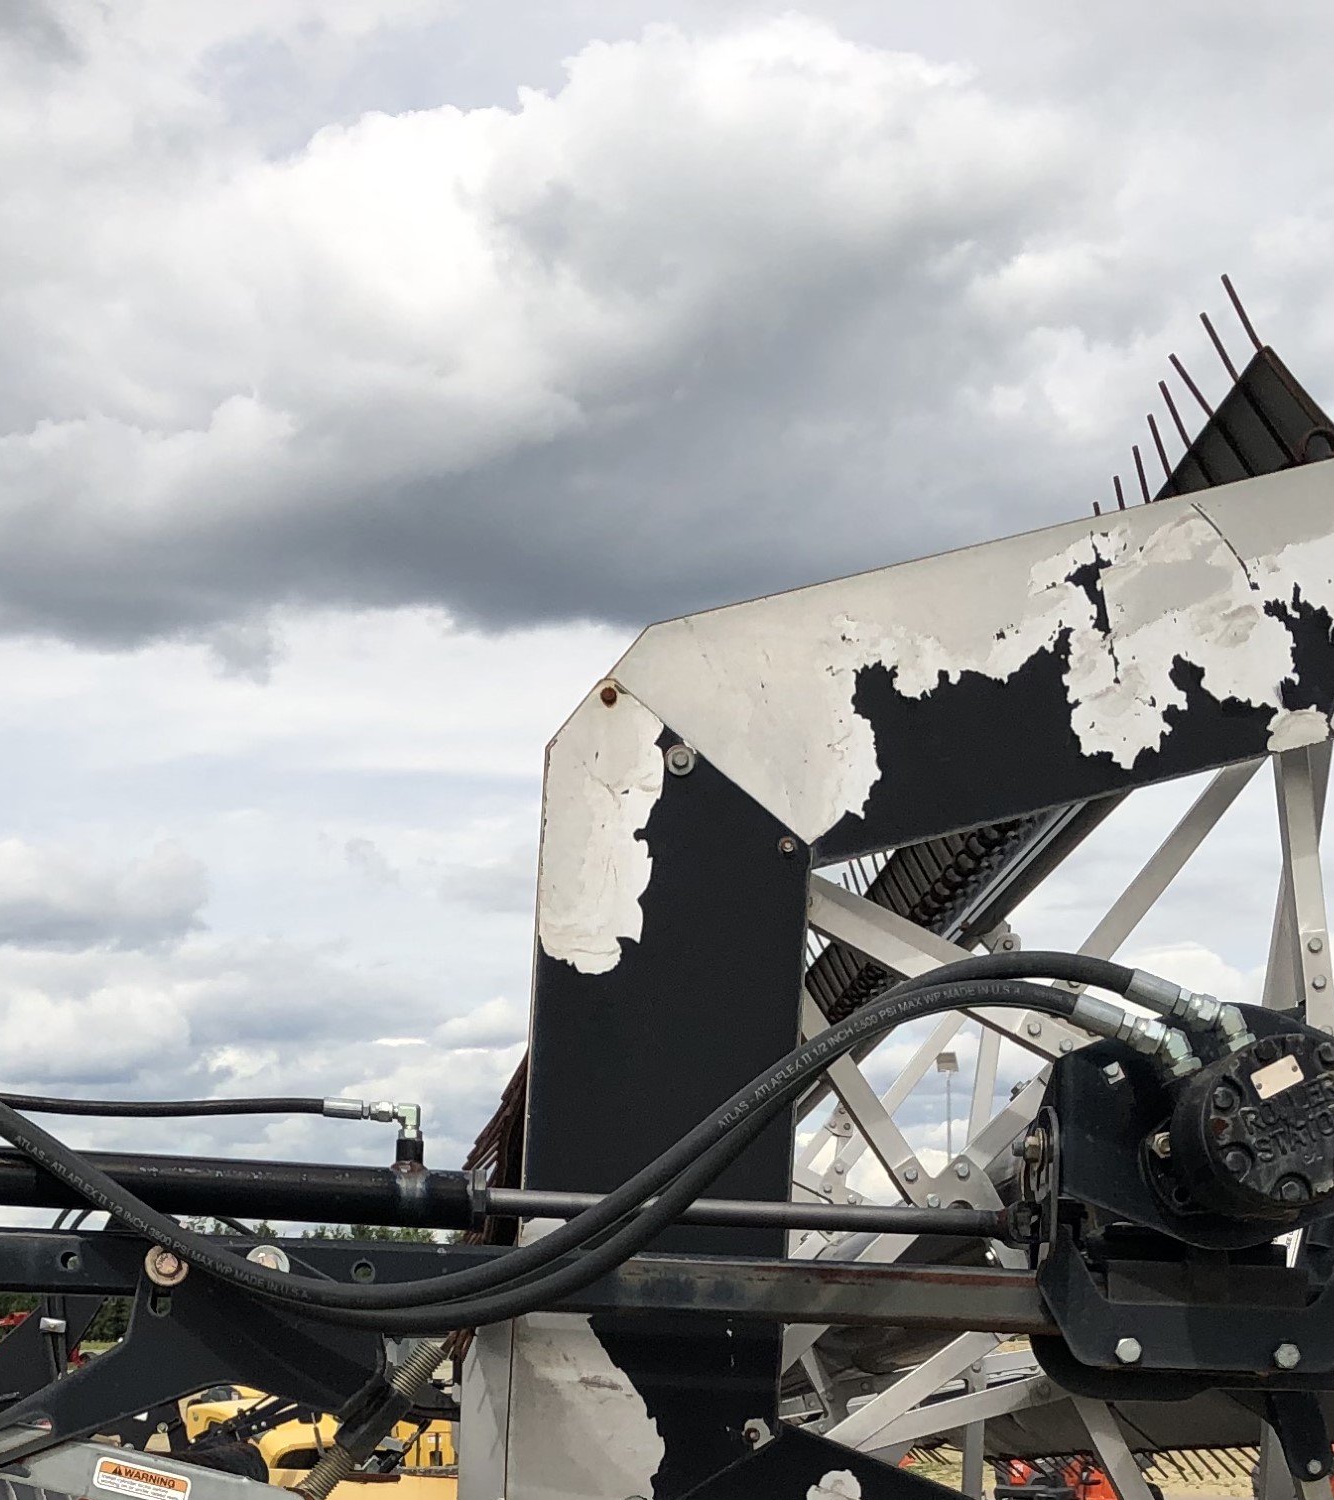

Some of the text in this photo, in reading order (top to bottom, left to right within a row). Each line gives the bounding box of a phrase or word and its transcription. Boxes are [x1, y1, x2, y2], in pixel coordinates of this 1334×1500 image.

[717, 1100, 749, 1129] ATLAS
[754, 1058, 803, 1101] ATLAFLEX
[812, 1042, 828, 1057] 1/2
[827, 1026, 854, 1048] INCH
[879, 1005, 898, 1020] PSI
[897, 997, 923, 1013] MAX
[923, 991, 942, 1005] WP
[943, 985, 976, 999] MADE
[977, 983, 989, 995] IN
[14, 1135, 46, 1160] ATLAS
[50, 1161, 99, 1198] ATLAFLEX
[109, 1201, 123, 1215] 1/2
[124, 1211, 148, 1231] INCH
[148, 1227, 172, 1246] 3500
[172, 1241, 191, 1255] PSI
[191, 1250, 214, 1268] MAX
[215, 1263, 233, 1275] WP
[234, 1270, 265, 1288] MADE
[266, 1281, 279, 1292] IN
[123, 1466, 176, 1489] WARNING
